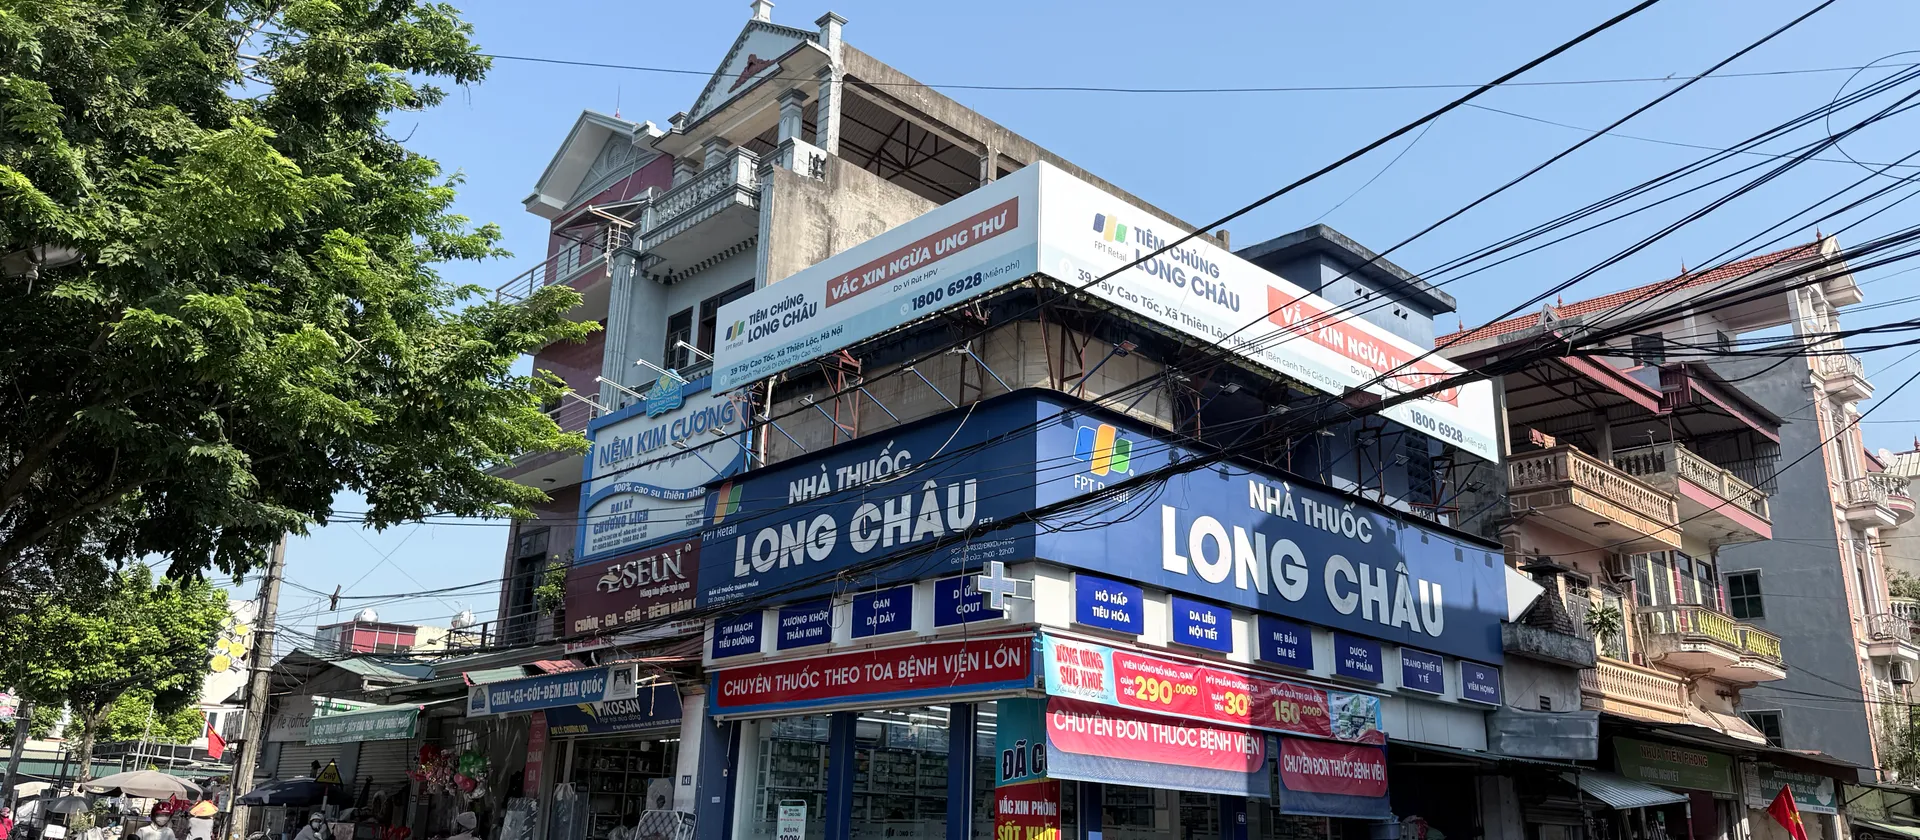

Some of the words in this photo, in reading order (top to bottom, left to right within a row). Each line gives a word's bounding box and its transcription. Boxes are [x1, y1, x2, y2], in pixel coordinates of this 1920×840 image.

[831, 274, 860, 299] VẮC
[862, 265, 886, 287] XIN
[889, 246, 931, 276] NGỪA
[935, 230, 968, 255] UNG
[972, 209, 1007, 239] THƯ
[1094, 240, 1107, 253] FPT
[1108, 246, 1127, 262] Retail
[1134, 226, 1166, 254] TIÊM
[1170, 245, 1219, 279] CHỦNG
[893, 283, 902, 292] Do
[923, 268, 938, 281] HPV
[1135, 248, 1186, 288] LONG
[1191, 275, 1240, 313] CHÂU
[912, 287, 943, 311] 1800
[947, 272, 982, 296] 6928
[1078, 268, 1091, 283] 39
[1117, 286, 1138, 303] Cao
[1141, 295, 1162, 316] Tốc,
[1165, 306, 1178, 321] Xã
[1181, 312, 1209, 334] Thiên
[749, 308, 768, 326] TIÊM
[770, 293, 804, 316] CHỦNG
[748, 318, 780, 343] LONG
[782, 301, 817, 328] CHÂU
[730, 367, 737, 376] 39
[750, 359, 762, 367] Cao
[821, 331, 830, 341] Hà
[831, 325, 843, 337] Nội
[1317, 322, 1343, 350] XIN
[1347, 338, 1389, 370] NGỪA
[600, 436, 633, 469] NỆM
[637, 424, 667, 454] KIM
[670, 400, 734, 441] CƯƠNG
[1410, 409, 1435, 431] 1800
[1438, 423, 1463, 443] 6928
[788, 463, 831, 505] NHÀ
[836, 439, 911, 490] THUỐC
[614, 482, 631, 493] 100%
[633, 485, 648, 494] cao
[651, 488, 661, 498] su
[663, 489, 684, 499] thiên
[1074, 474, 1094, 493] FPT
[1249, 479, 1298, 522] NHÀ
[1301, 497, 1373, 543] THUỐC
[734, 513, 837, 578] LONG
[849, 478, 977, 553] CHÂU
[1162, 504, 1309, 602] LONG
[1324, 554, 1444, 638] CHÂU
[872, 598, 890, 610] GAN
[956, 601, 981, 614] GOUT
[1095, 590, 1109, 603] HÔ
[1110, 592, 1128, 606] HẤP
[605, 613, 618, 626] GA
[783, 615, 807, 627] XƯƠNG
[808, 610, 829, 623] KHỚP
[866, 615, 878, 627] DẠ
[879, 611, 896, 625] DÀY
[1092, 605, 1109, 619] TIÊU
[1111, 608, 1130, 624] HÓA
[1189, 610, 1201, 622] DA
[1202, 611, 1216, 625] LIỄU
[734, 622, 753, 637] MẠCH
[786, 628, 805, 641] THẦN
[805, 626, 823, 639] KINH
[1188, 625, 1204, 640] NỘI
[1204, 626, 1218, 641] TIẾT
[1273, 631, 1283, 645] MẸ
[1284, 632, 1298, 645] BẦU
[719, 638, 731, 649] TIỂU
[732, 634, 755, 647] ĐƯỜNG
[1350, 646, 1367, 658] DƯỢC
[1277, 646, 1286, 657] EM
[1288, 647, 1296, 659] BÉ
[724, 673, 771, 697] CHUYÊN
[775, 664, 820, 691] THUỐC
[824, 667, 860, 686] THEO
[865, 663, 893, 682] TOA
[898, 656, 938, 683] BỆNH
[943, 651, 980, 678] VIỆN
[984, 645, 1021, 670] LỚN
[1122, 659, 1138, 671] VIÊN
[1138, 662, 1155, 674] UỐNG
[1345, 658, 1355, 669] MỸ
[1356, 659, 1373, 673] PHẨM
[1403, 657, 1421, 670] TRANG
[1422, 659, 1436, 671] THIẾT
[563, 678, 578, 697] HÀN
[581, 673, 604, 698] QUỐC
[1418, 674, 1423, 683] Y
[1423, 673, 1429, 684] TẾ
[1476, 671, 1484, 680] HO
[1467, 683, 1478, 692] VIÊM
[1479, 684, 1495, 695] HỌNG
[1224, 691, 1254, 716] 30%
[1053, 709, 1113, 737] CHUYÊN
[1116, 718, 1148, 742] ĐƠN
[1150, 720, 1198, 746] THUỐC
[1200, 726, 1231, 755] BỆNH
[1234, 730, 1260, 760] VIỆN
[1002, 739, 1027, 782] ĐÃ
[1031, 743, 1047, 775] C
[1640, 745, 1662, 761] NHỰA
[1684, 751, 1708, 768] PHONG
[1284, 752, 1313, 775] CHUYÊN
[1313, 757, 1330, 776] ĐƠN
[1330, 754, 1353, 778] THUỐC
[1354, 757, 1370, 784] BỆNH
[1371, 760, 1385, 785] VIỆN
[999, 795, 1014, 815] VẮC
[1015, 800, 1029, 815] XIN
[1031, 798, 1056, 816] PHÒNG
[1238, 814, 1246, 823] 66
